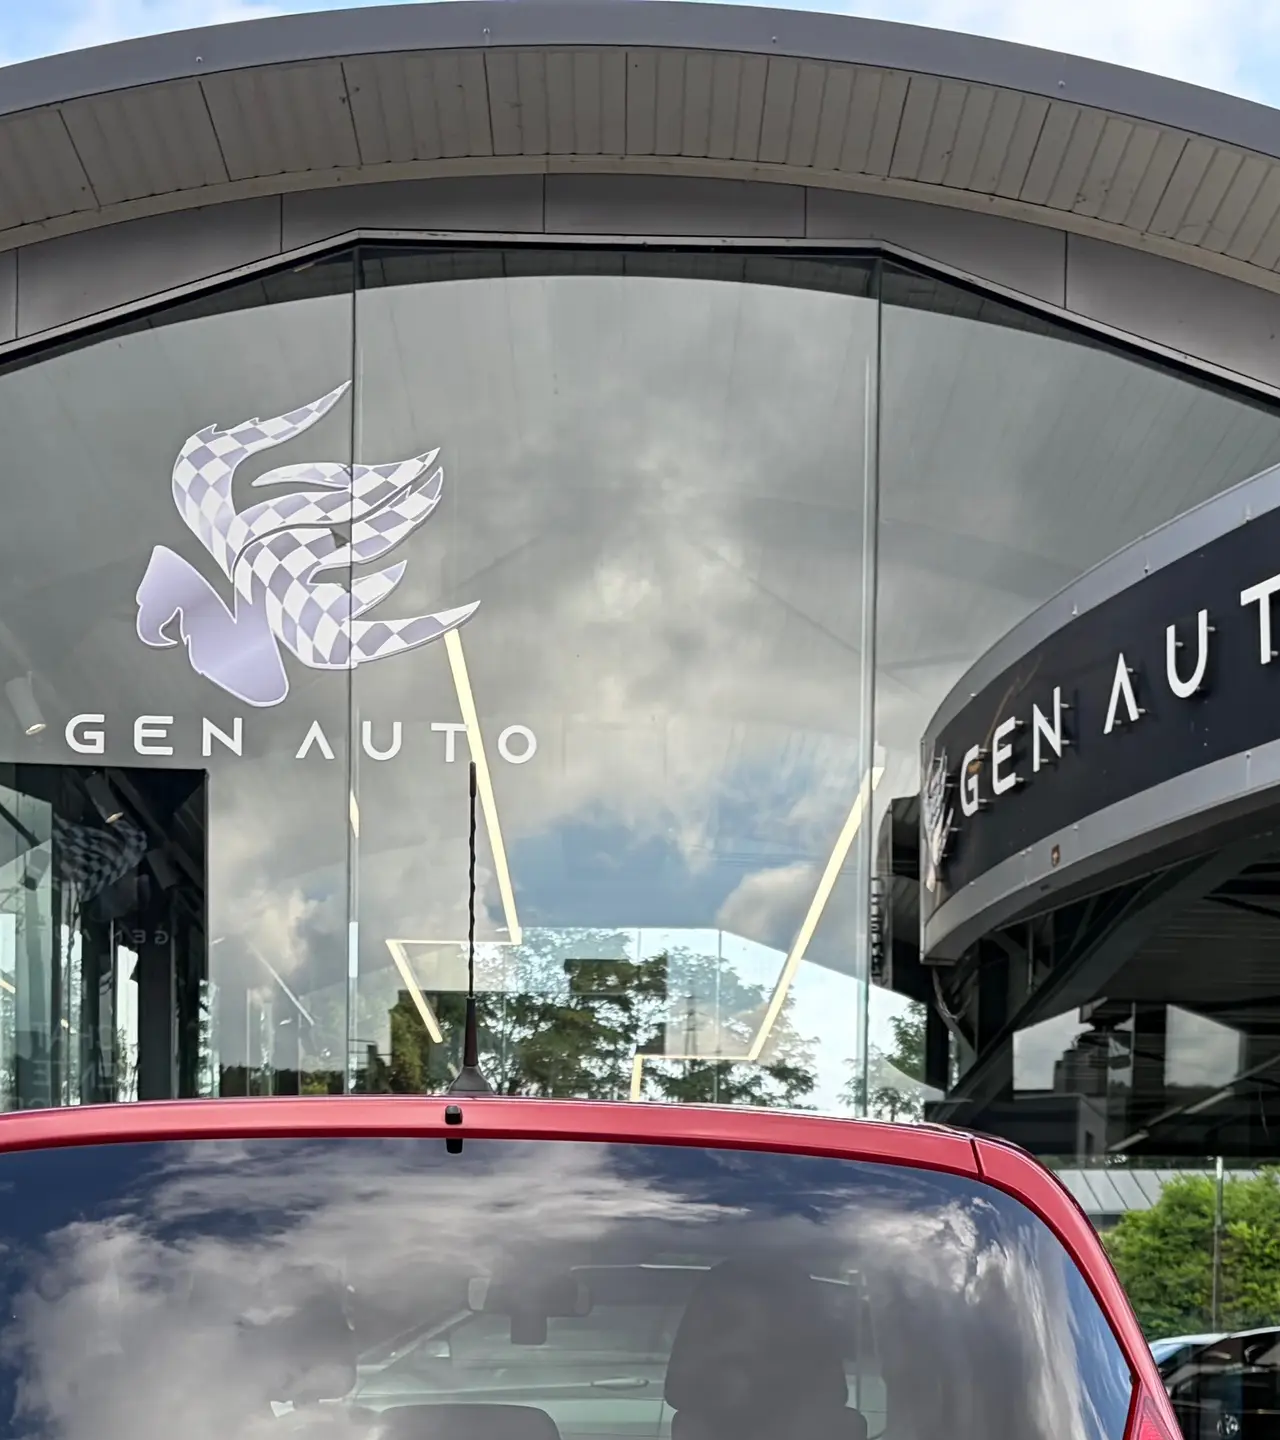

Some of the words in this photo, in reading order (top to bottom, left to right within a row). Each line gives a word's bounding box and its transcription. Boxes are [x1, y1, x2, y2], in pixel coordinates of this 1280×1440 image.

[65, 713, 243, 757] GEN
[295, 720, 538, 764] AUTO
[959, 685, 1063, 817] GEN
